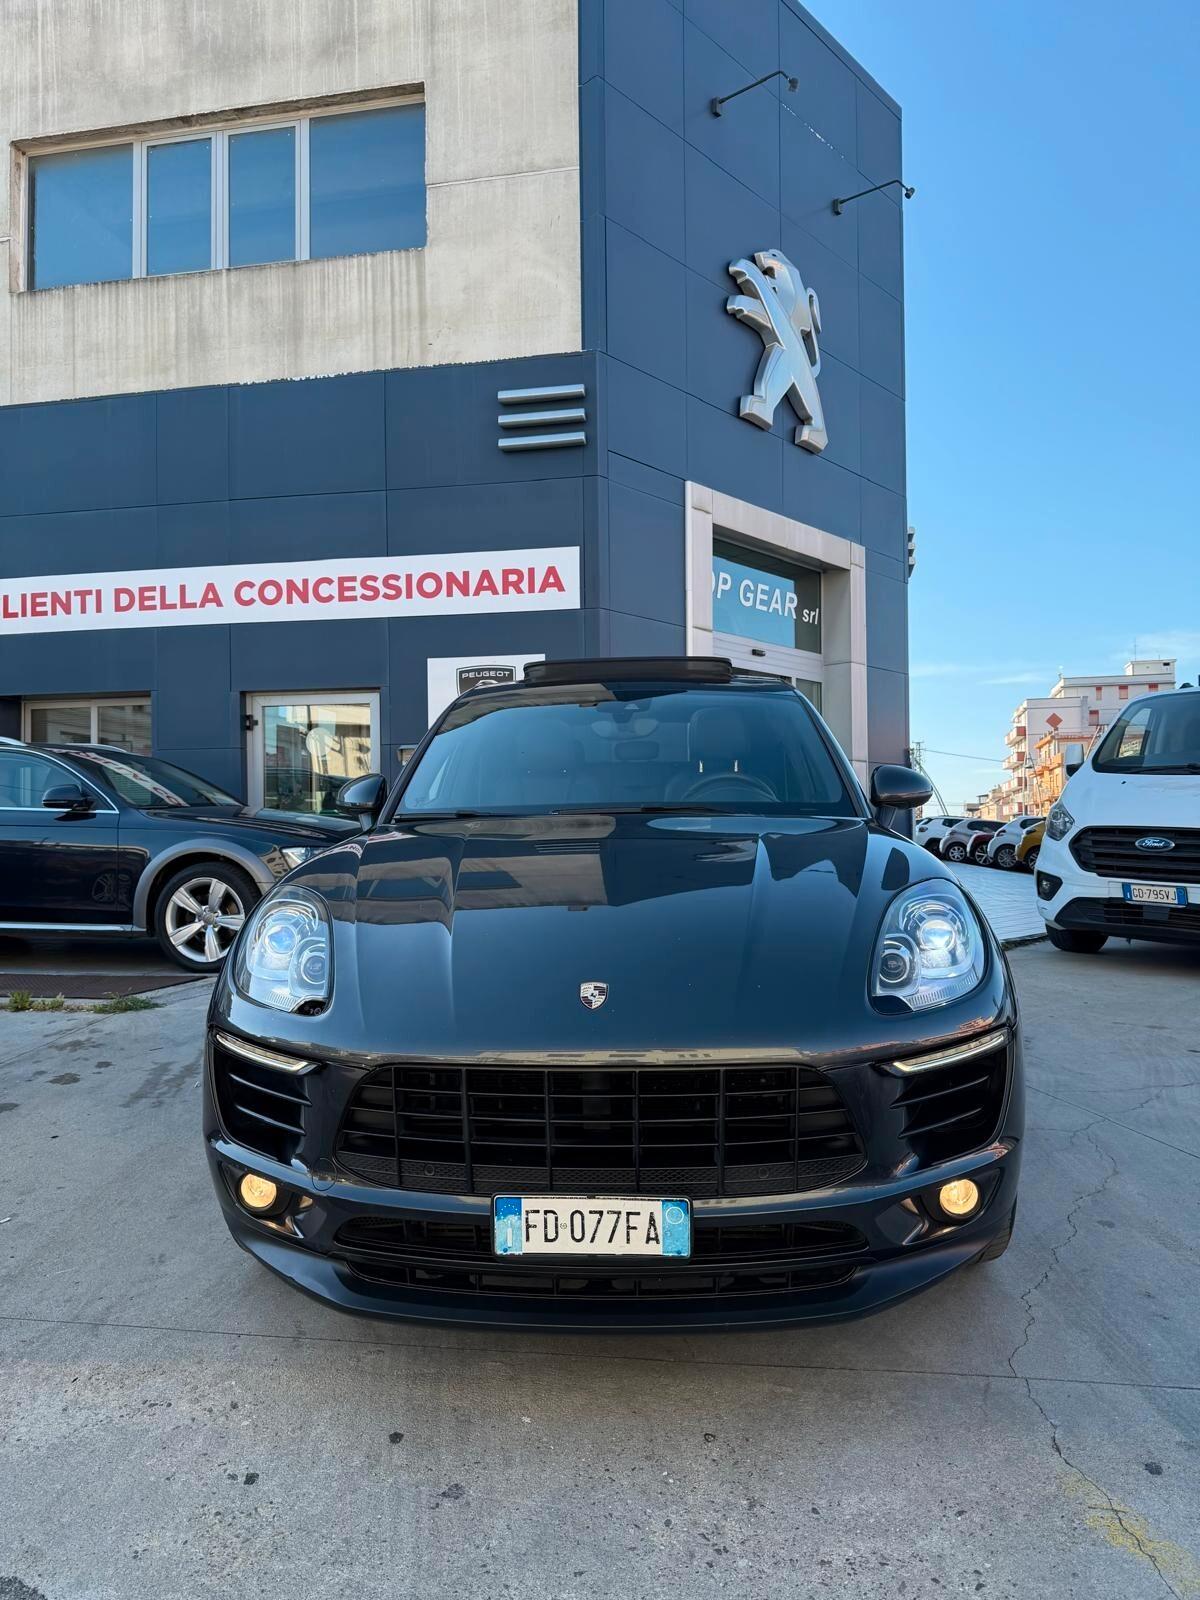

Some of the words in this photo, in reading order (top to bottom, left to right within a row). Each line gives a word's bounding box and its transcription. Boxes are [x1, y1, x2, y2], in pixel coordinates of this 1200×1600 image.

[2, 589, 102, 619] LIENTI
[114, 582, 224, 612] DELLA
[234, 566, 566, 607] CONCESSIONARIA
[712, 571, 731, 599] P
[740, 579, 798, 619] GEAR
[802, 608, 819, 625] srl
[462, 670, 510, 679] PEUGEOT
[1142, 839, 1165, 848] Ford
